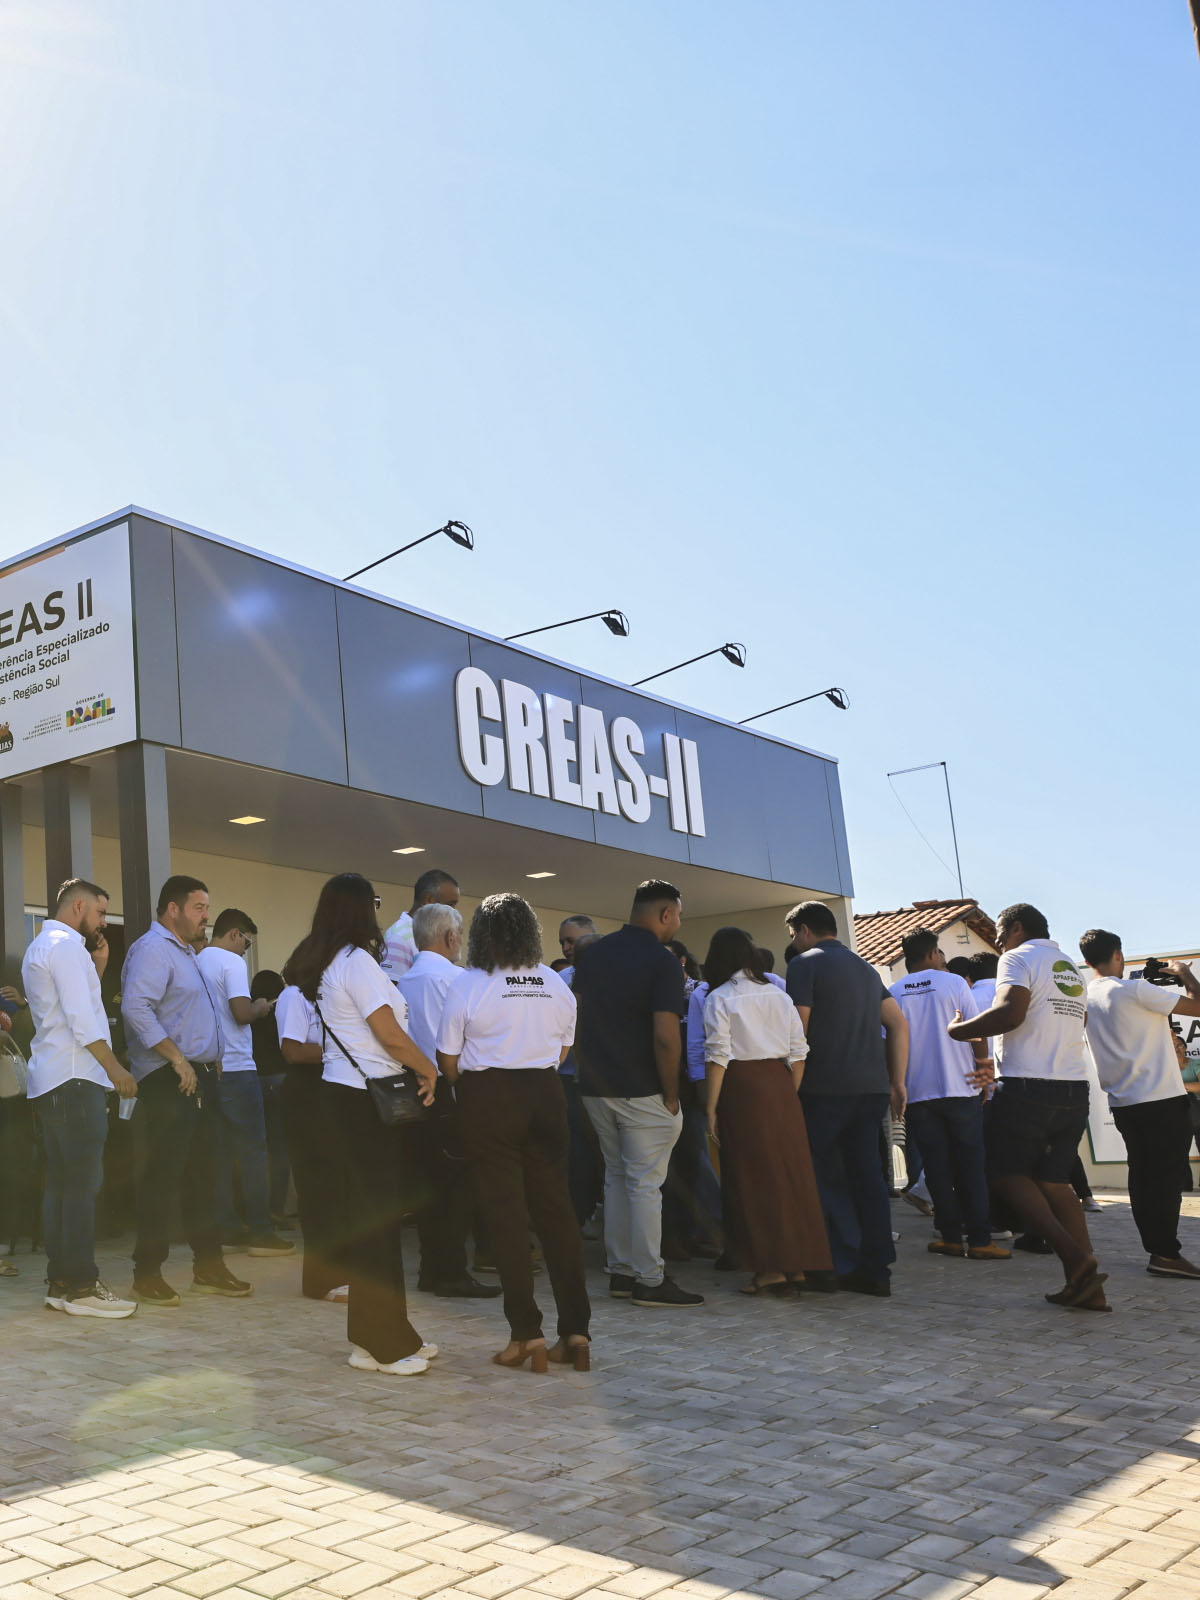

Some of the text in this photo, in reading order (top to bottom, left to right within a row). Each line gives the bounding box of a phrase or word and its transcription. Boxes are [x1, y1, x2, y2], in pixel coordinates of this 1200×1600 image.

[77, 578, 93, 621] II
[36, 622, 110, 656] Especializado
[38, 649, 70, 671] Social
[13, 683, 44, 701] Região
[45, 674, 60, 690] Sul
[65, 697, 116, 728] BRASIL
[455, 666, 706, 837] CREAS-II
[506, 976, 544, 985] PALMAS
